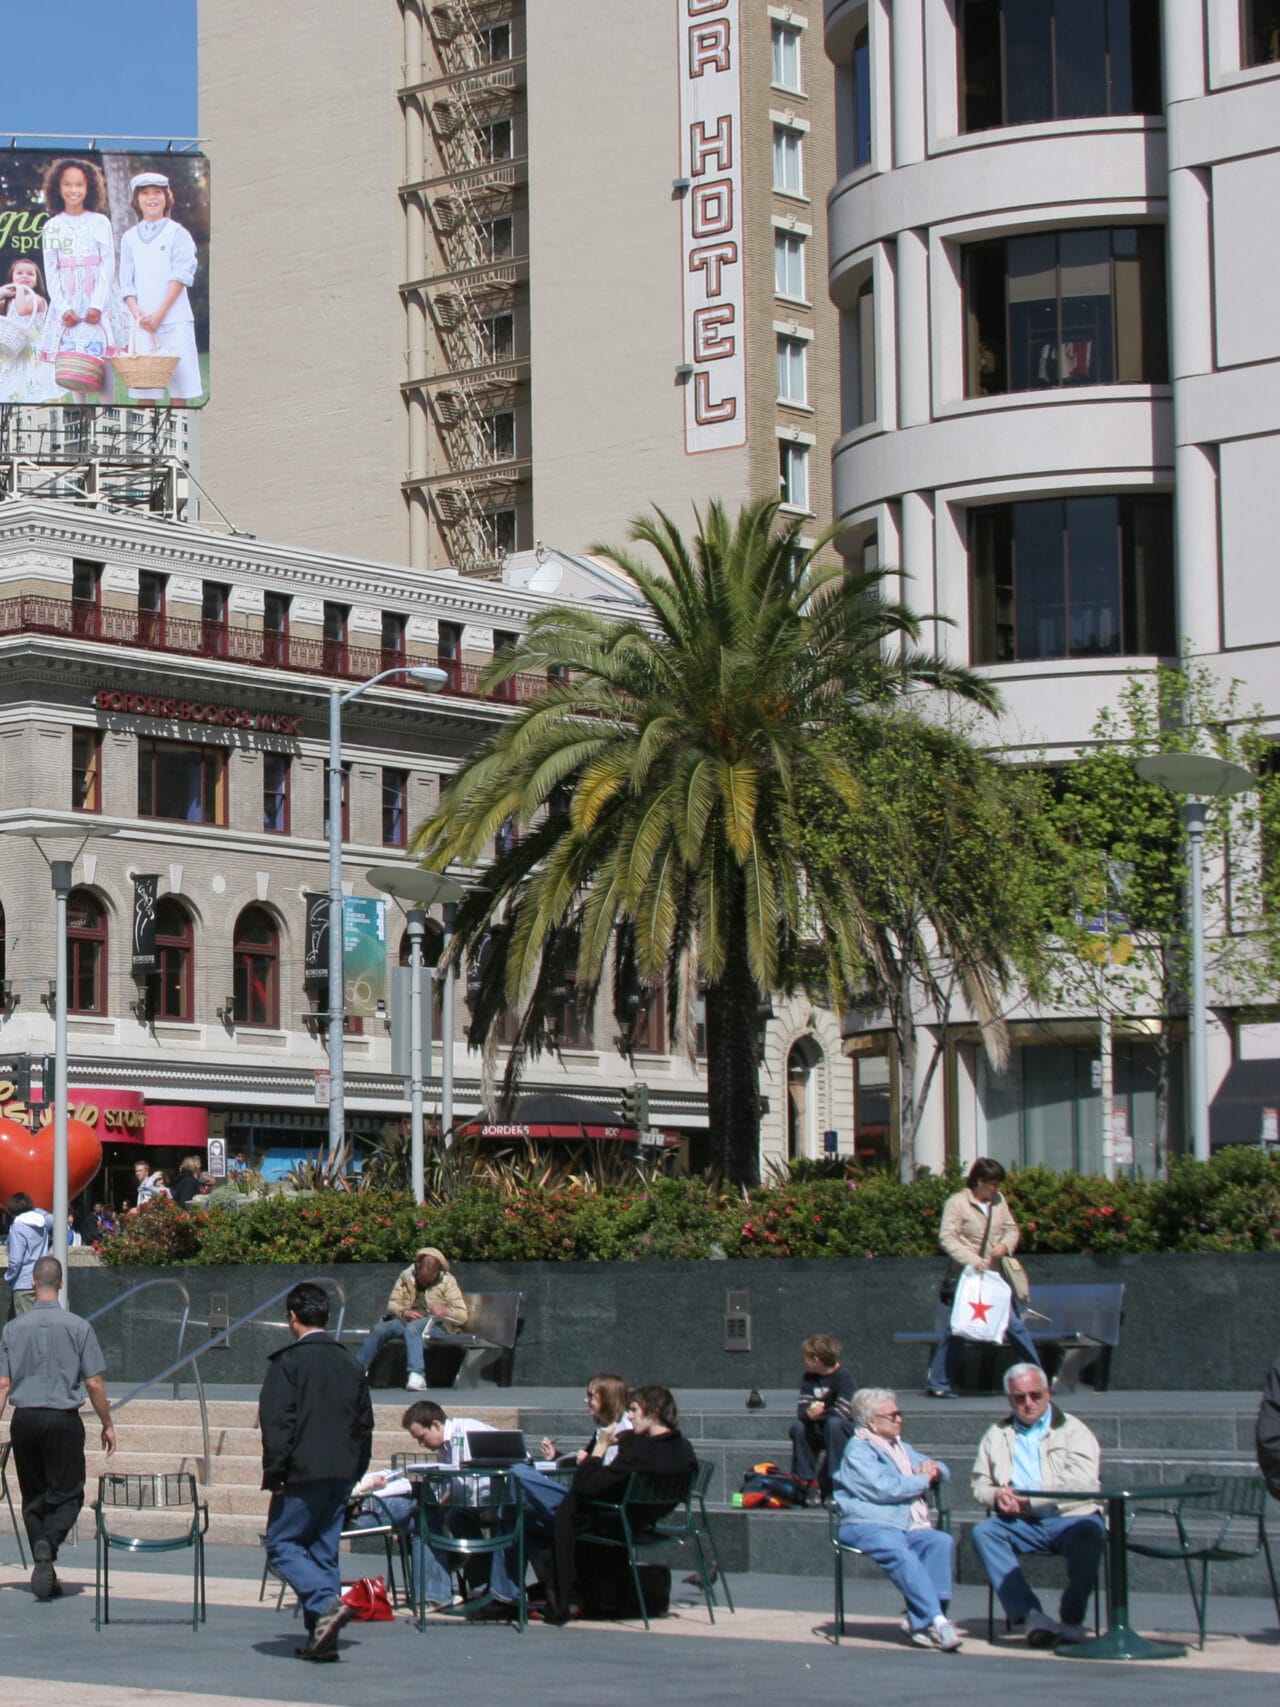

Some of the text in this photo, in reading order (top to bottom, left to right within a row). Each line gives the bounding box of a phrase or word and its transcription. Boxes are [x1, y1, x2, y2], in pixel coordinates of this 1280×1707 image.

[688, 0, 737, 426] R HOTEL
[11, 235, 74, 254] spring
[97, 689, 305, 736] BORDERS BOOKS & MUSIC
[481, 1124, 530, 1135] BORDERS
